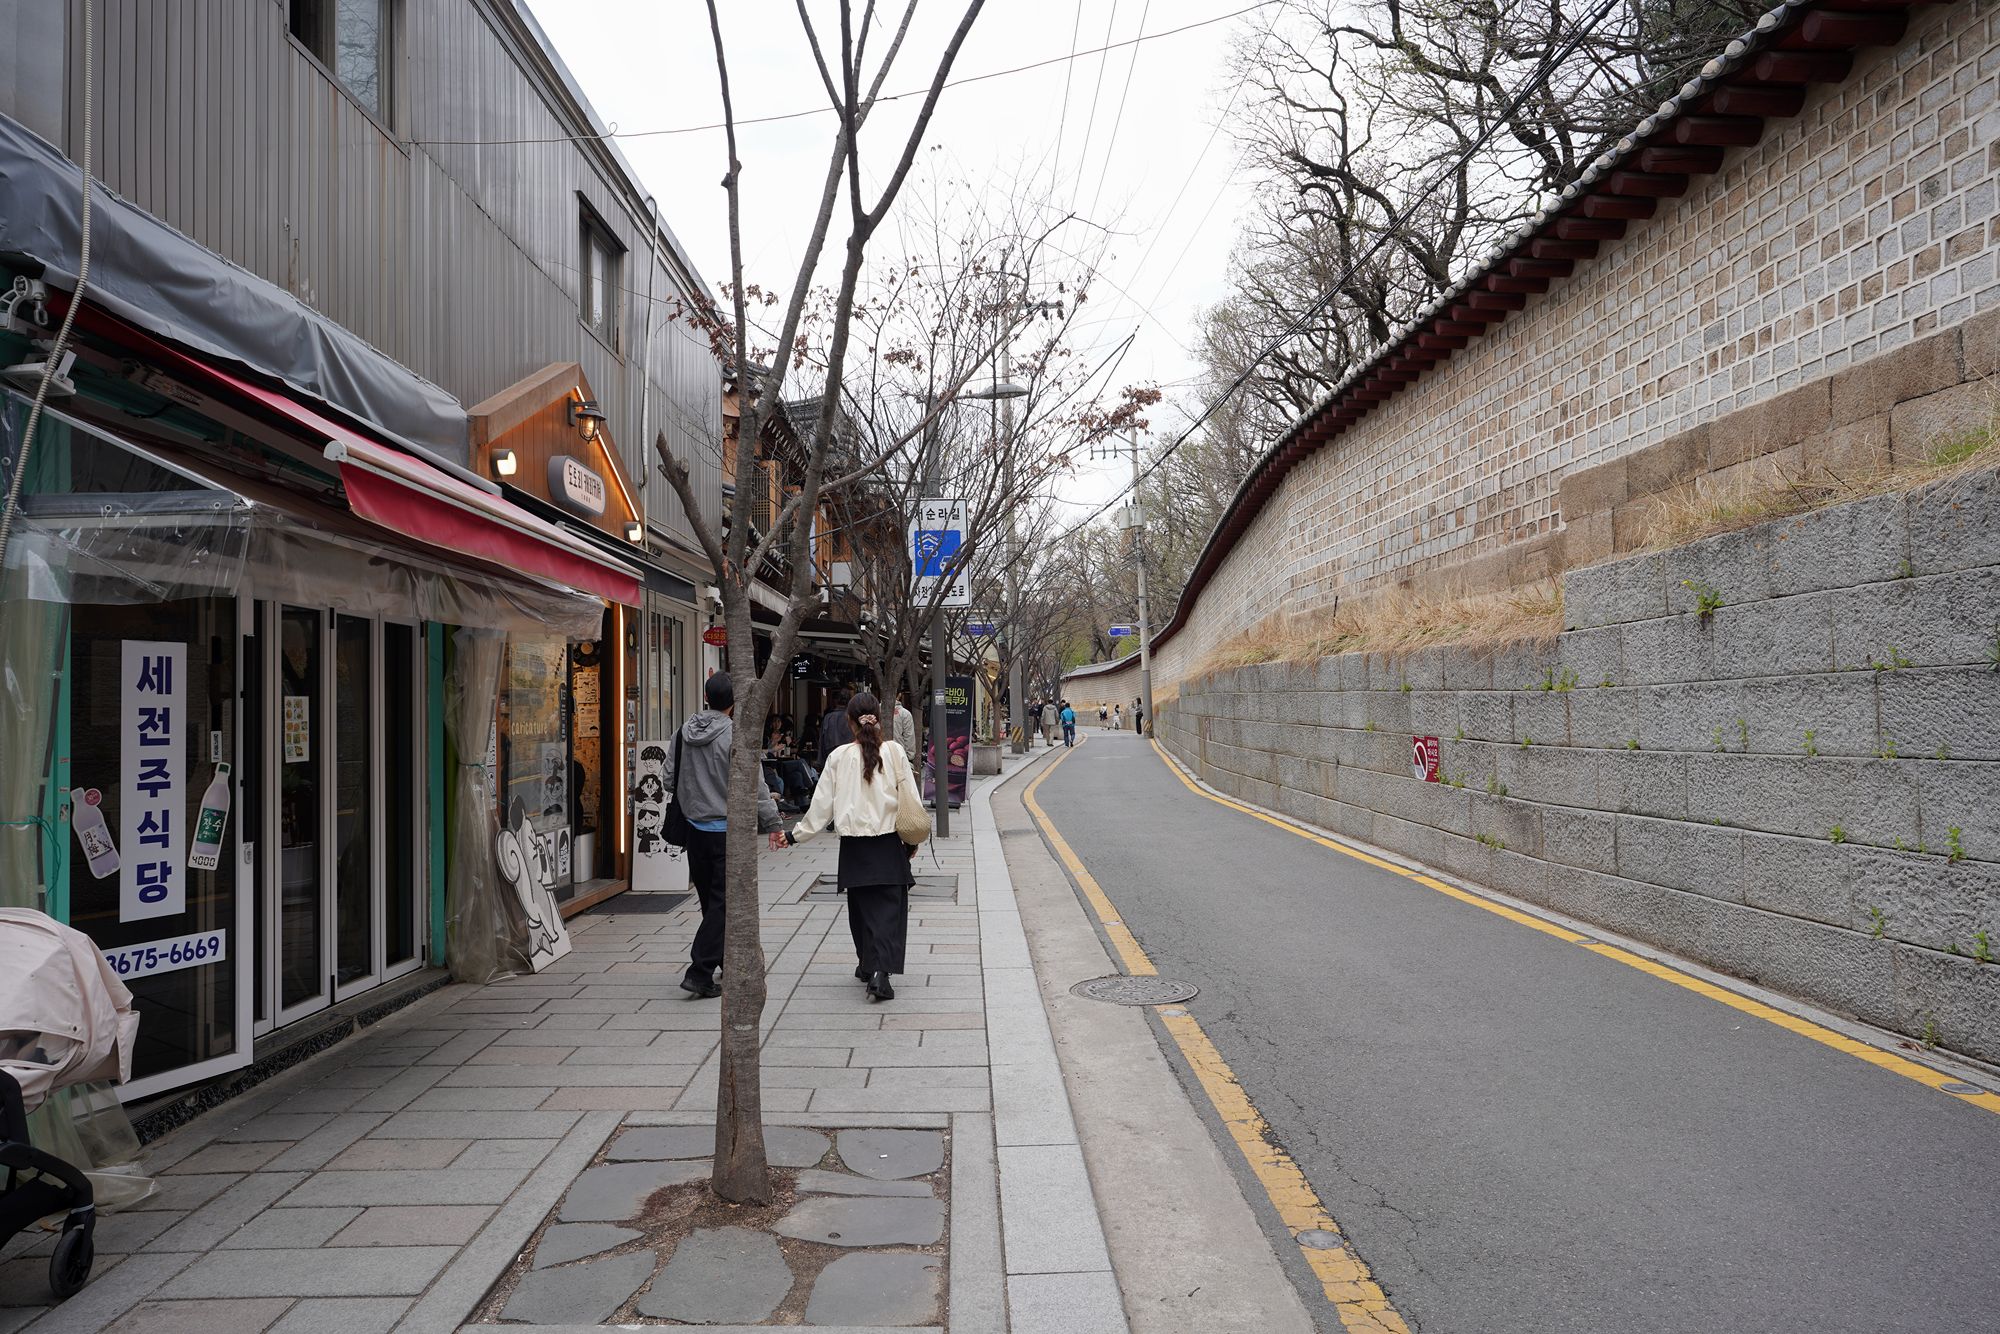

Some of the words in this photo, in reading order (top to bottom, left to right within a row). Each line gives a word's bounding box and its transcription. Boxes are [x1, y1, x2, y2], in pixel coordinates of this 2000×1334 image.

[568, 464, 583, 489] 도토리
[511, 720, 548, 736] caricature
[136, 655, 173, 904] 세전주식당
[202, 816, 222, 832] 장수
[191, 855, 216, 867] 4000
